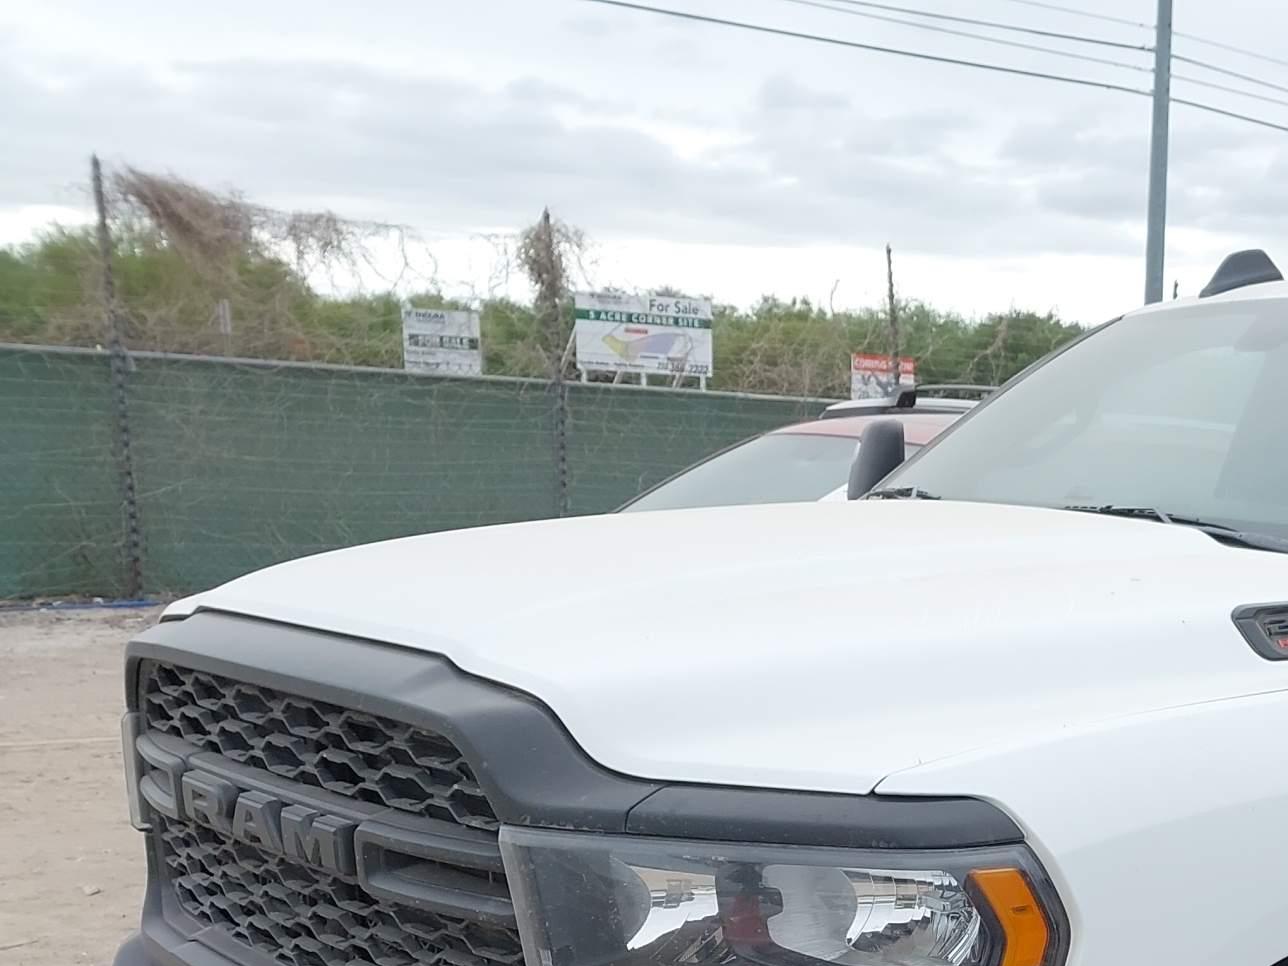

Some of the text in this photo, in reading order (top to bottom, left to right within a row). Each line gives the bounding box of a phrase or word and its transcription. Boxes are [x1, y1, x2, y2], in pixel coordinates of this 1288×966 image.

[648, 298, 700, 316] For Sale
[600, 311, 628, 323] ACRE
[631, 313, 675, 326] CORNER
[678, 318, 700, 328] SITE
[182, 769, 359, 876] RAM
